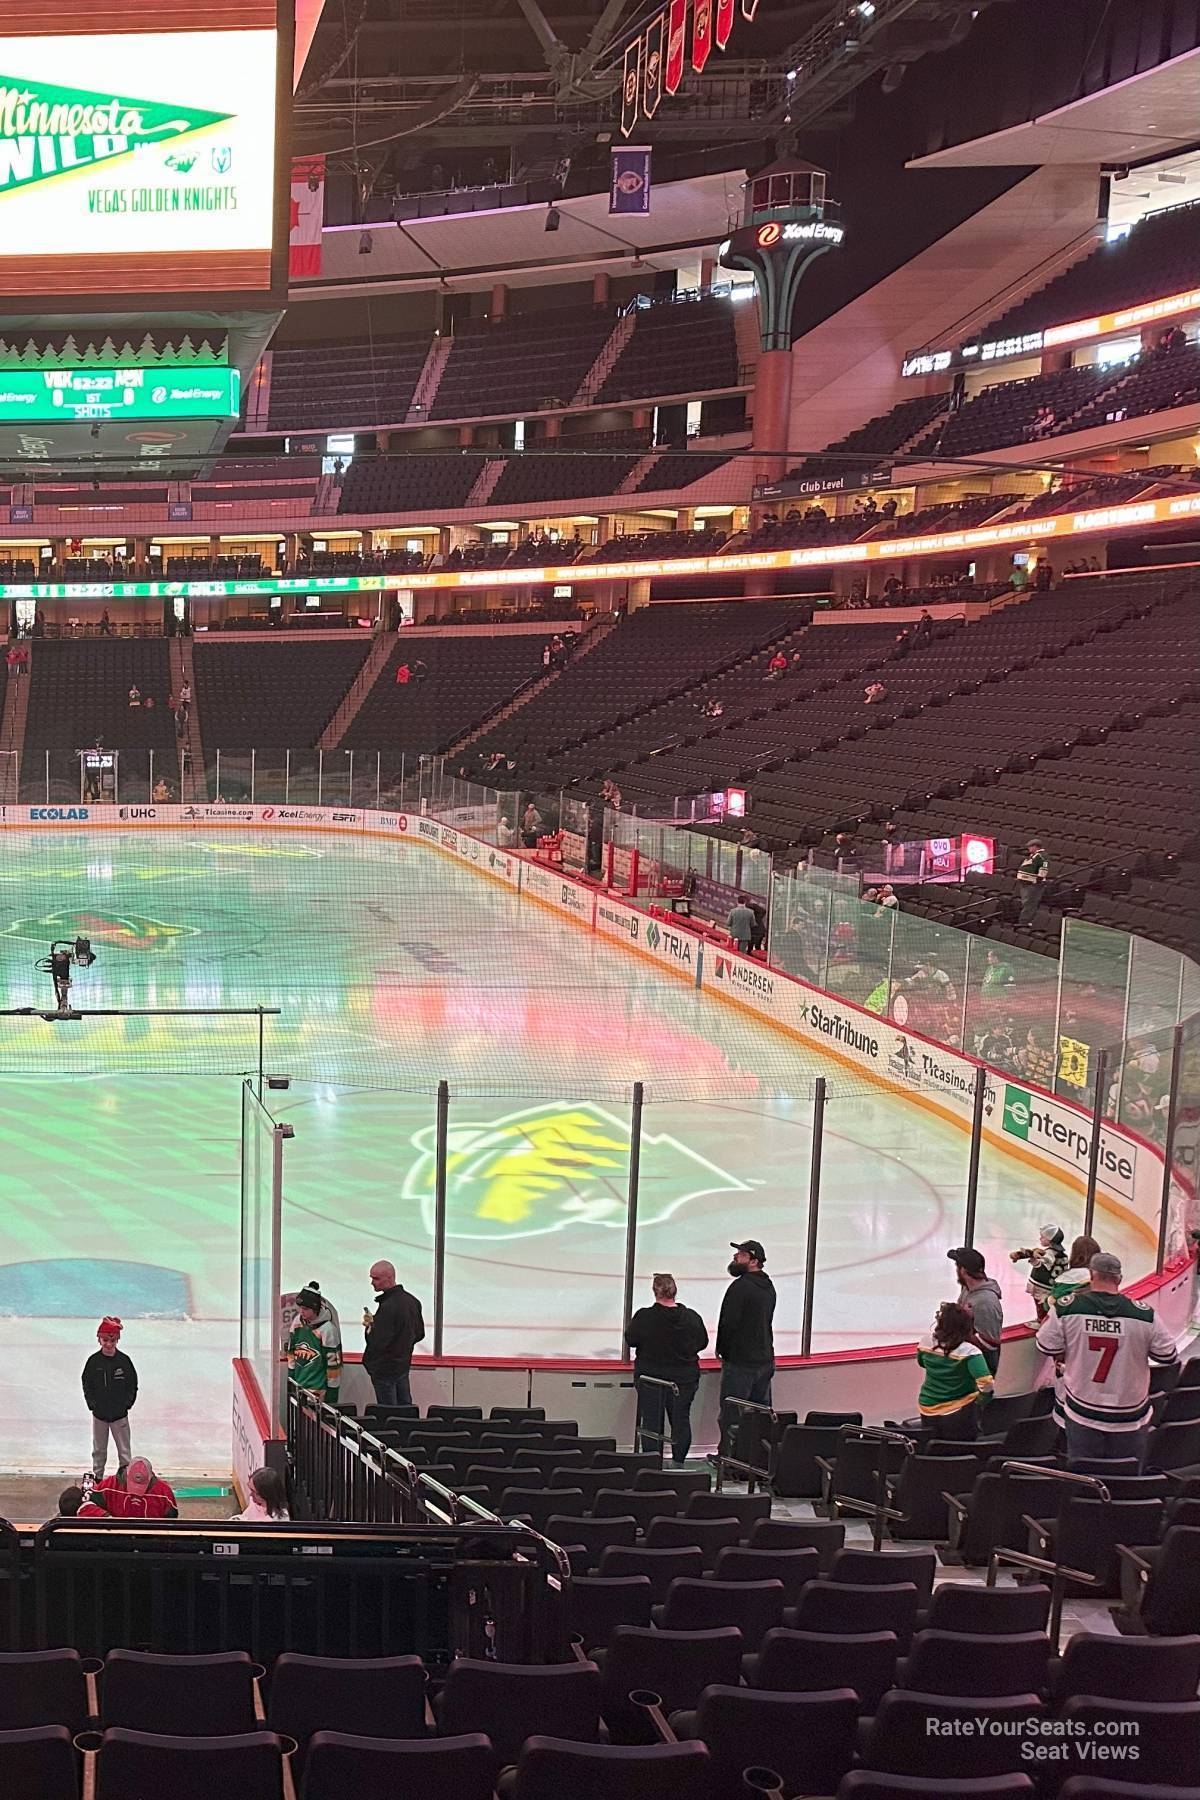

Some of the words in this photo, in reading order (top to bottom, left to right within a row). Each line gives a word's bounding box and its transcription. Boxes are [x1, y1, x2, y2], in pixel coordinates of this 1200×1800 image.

[88, 189, 127, 213] VEGAS
[131, 188, 179, 212] GOLDEN
[184, 186, 237, 211] KNIGHTS
[782, 223, 815, 239] Xcel
[815, 224, 844, 243] Energy
[800, 482, 820, 493] Club
[822, 478, 844, 491] Level
[30, 808, 89, 820] ECOLAB
[131, 809, 156, 818] UHC
[299, 811, 324, 821] Energy
[380, 817, 397, 826] BMO
[663, 932, 691, 964] TRIA
[732, 965, 774, 994] ANDERSEN
[810, 1005, 878, 1058] StarTribune
[1085, 1319, 1121, 1334] FABER
[1088, 1336, 1119, 1384] 7
